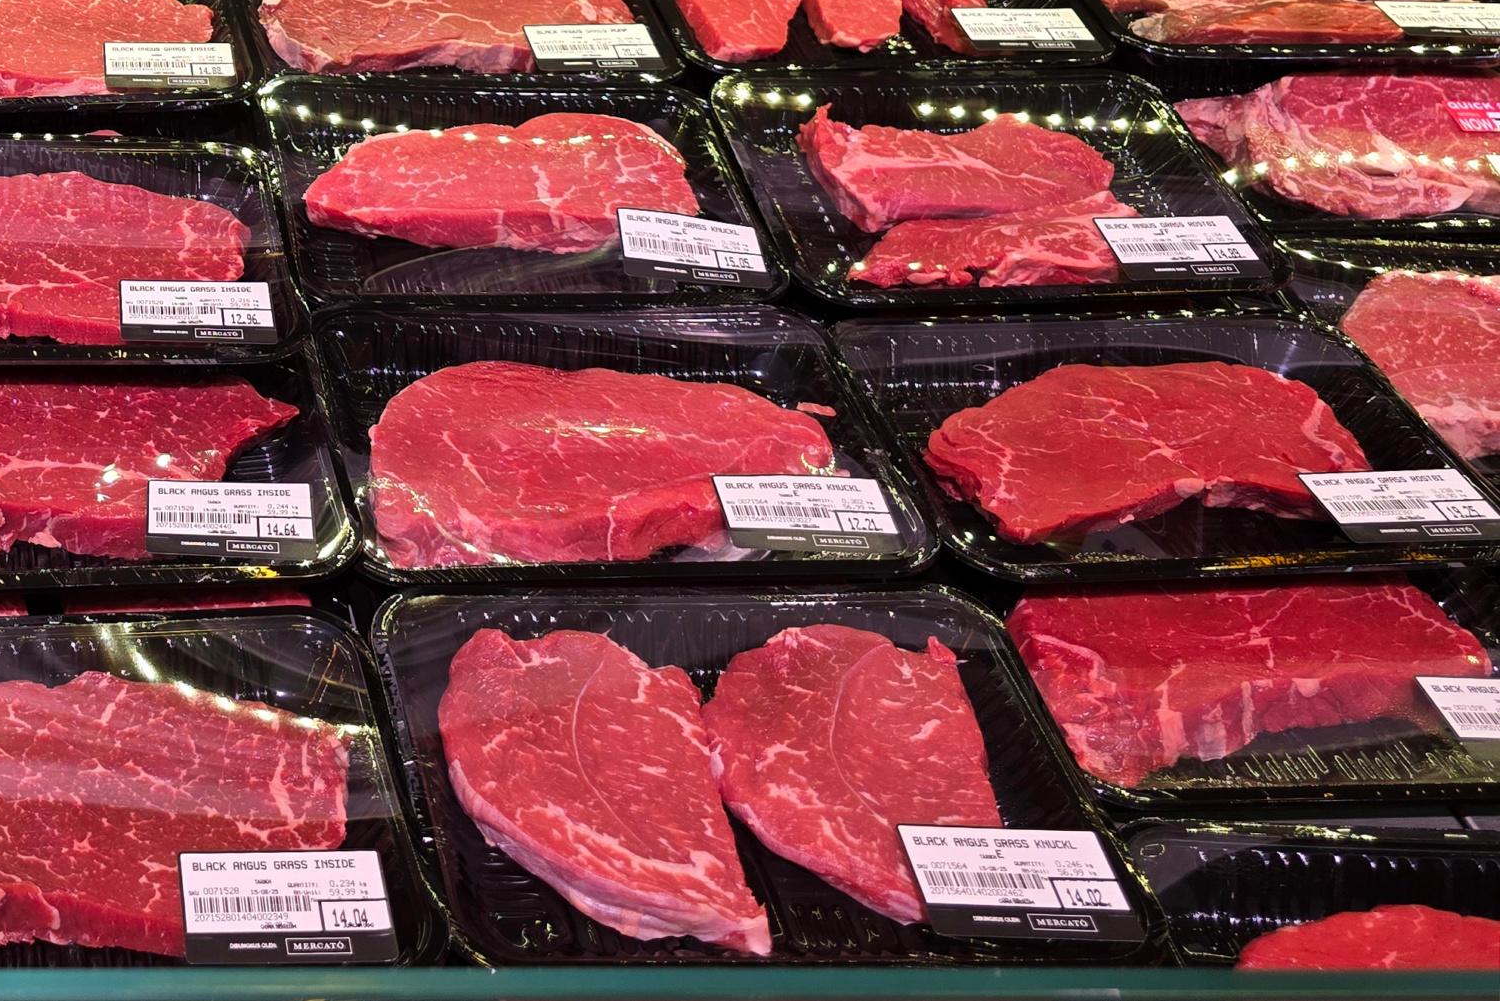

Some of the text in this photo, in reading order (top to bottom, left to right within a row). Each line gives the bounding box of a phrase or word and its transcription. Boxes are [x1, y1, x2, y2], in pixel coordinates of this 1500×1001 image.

[1447, 101, 1492, 111] QUICK
[1460, 119, 1492, 130] NOW
[759, 482, 788, 490] ANGUS
[827, 484, 861, 492] KNUCKL
[912, 836, 1077, 850] BLACK ANGUS GRASS KNUCKL
[193, 859, 355, 871] BLACK ANGUS GRASS INSIDE
